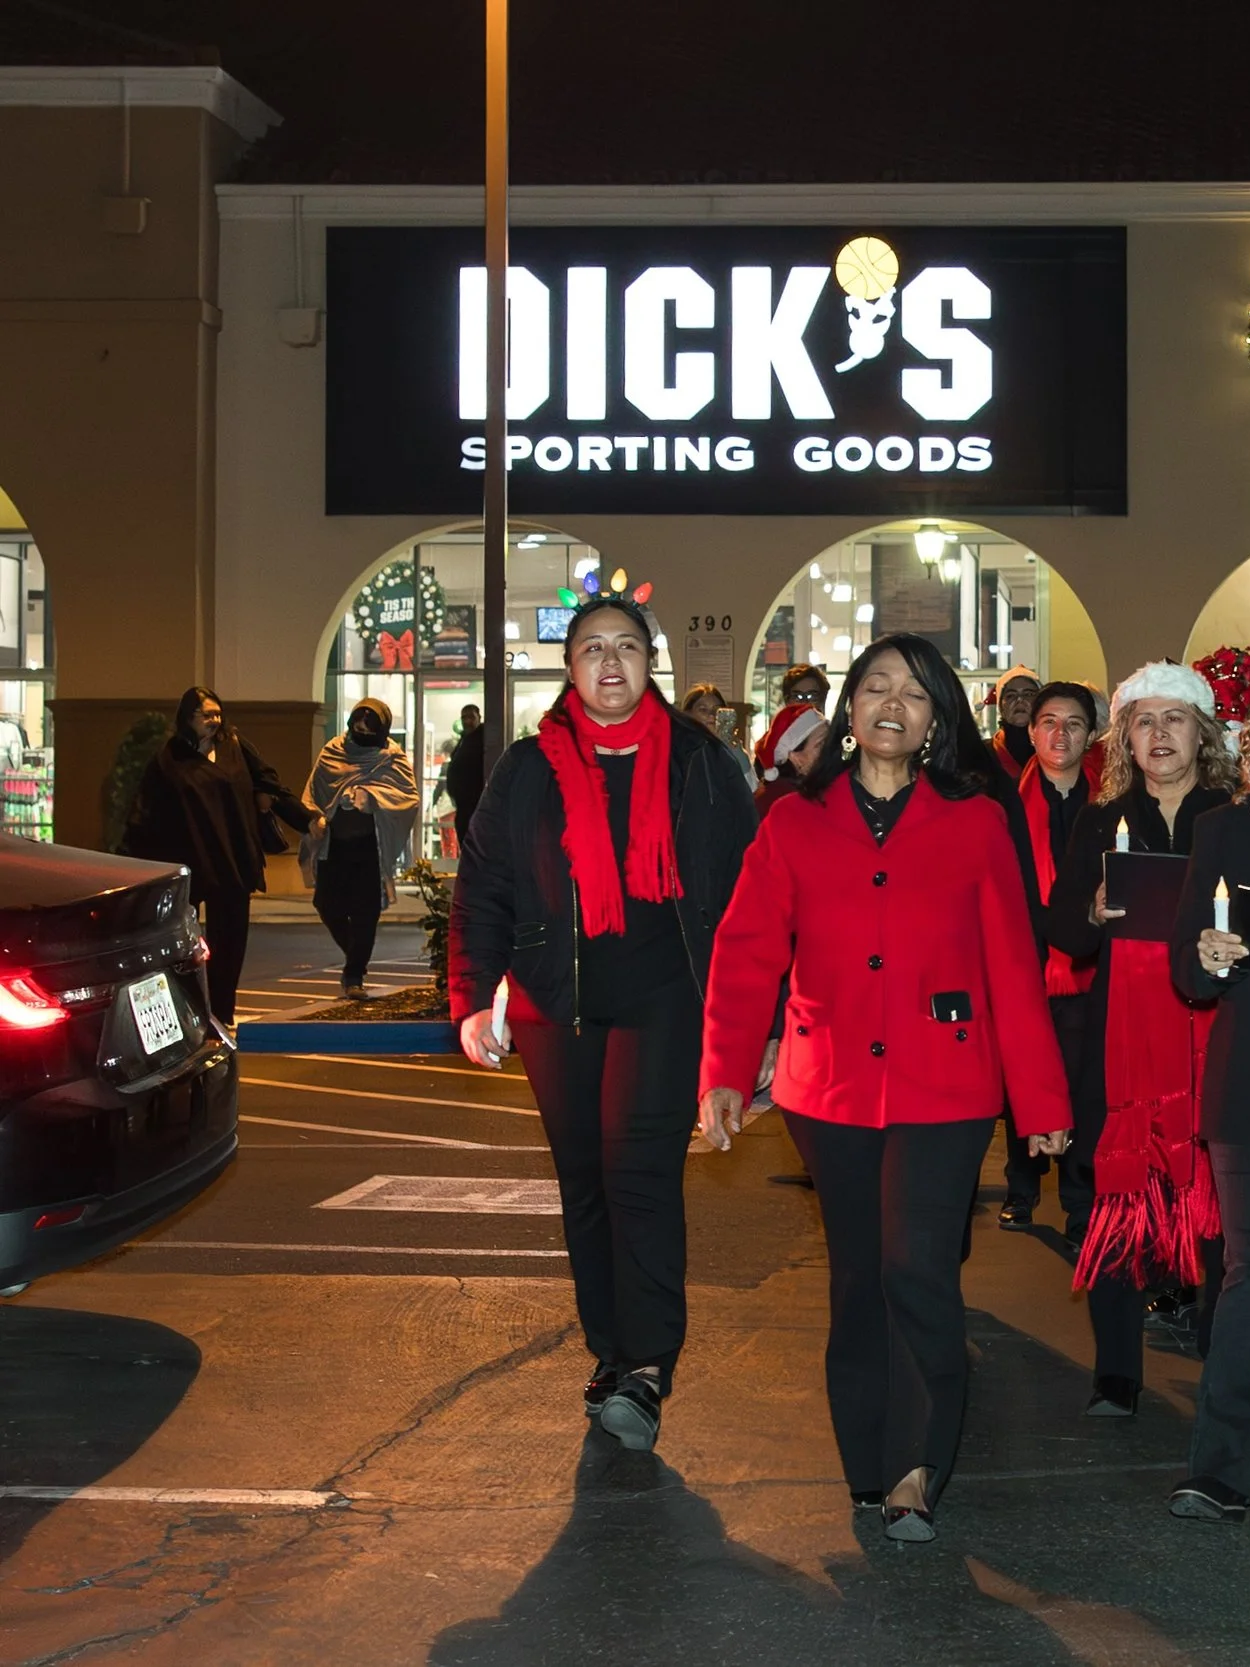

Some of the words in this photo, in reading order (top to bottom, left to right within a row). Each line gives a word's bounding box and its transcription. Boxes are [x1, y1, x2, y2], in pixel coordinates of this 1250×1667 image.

[459, 237, 992, 420] DICK'S
[460, 436, 755, 472] SPORTING
[793, 436, 993, 472] GOODS
[401, 596, 415, 610] TH
[380, 608, 415, 624] SEASO
[688, 615, 732, 631] 390
[505, 651, 530, 668] 90
